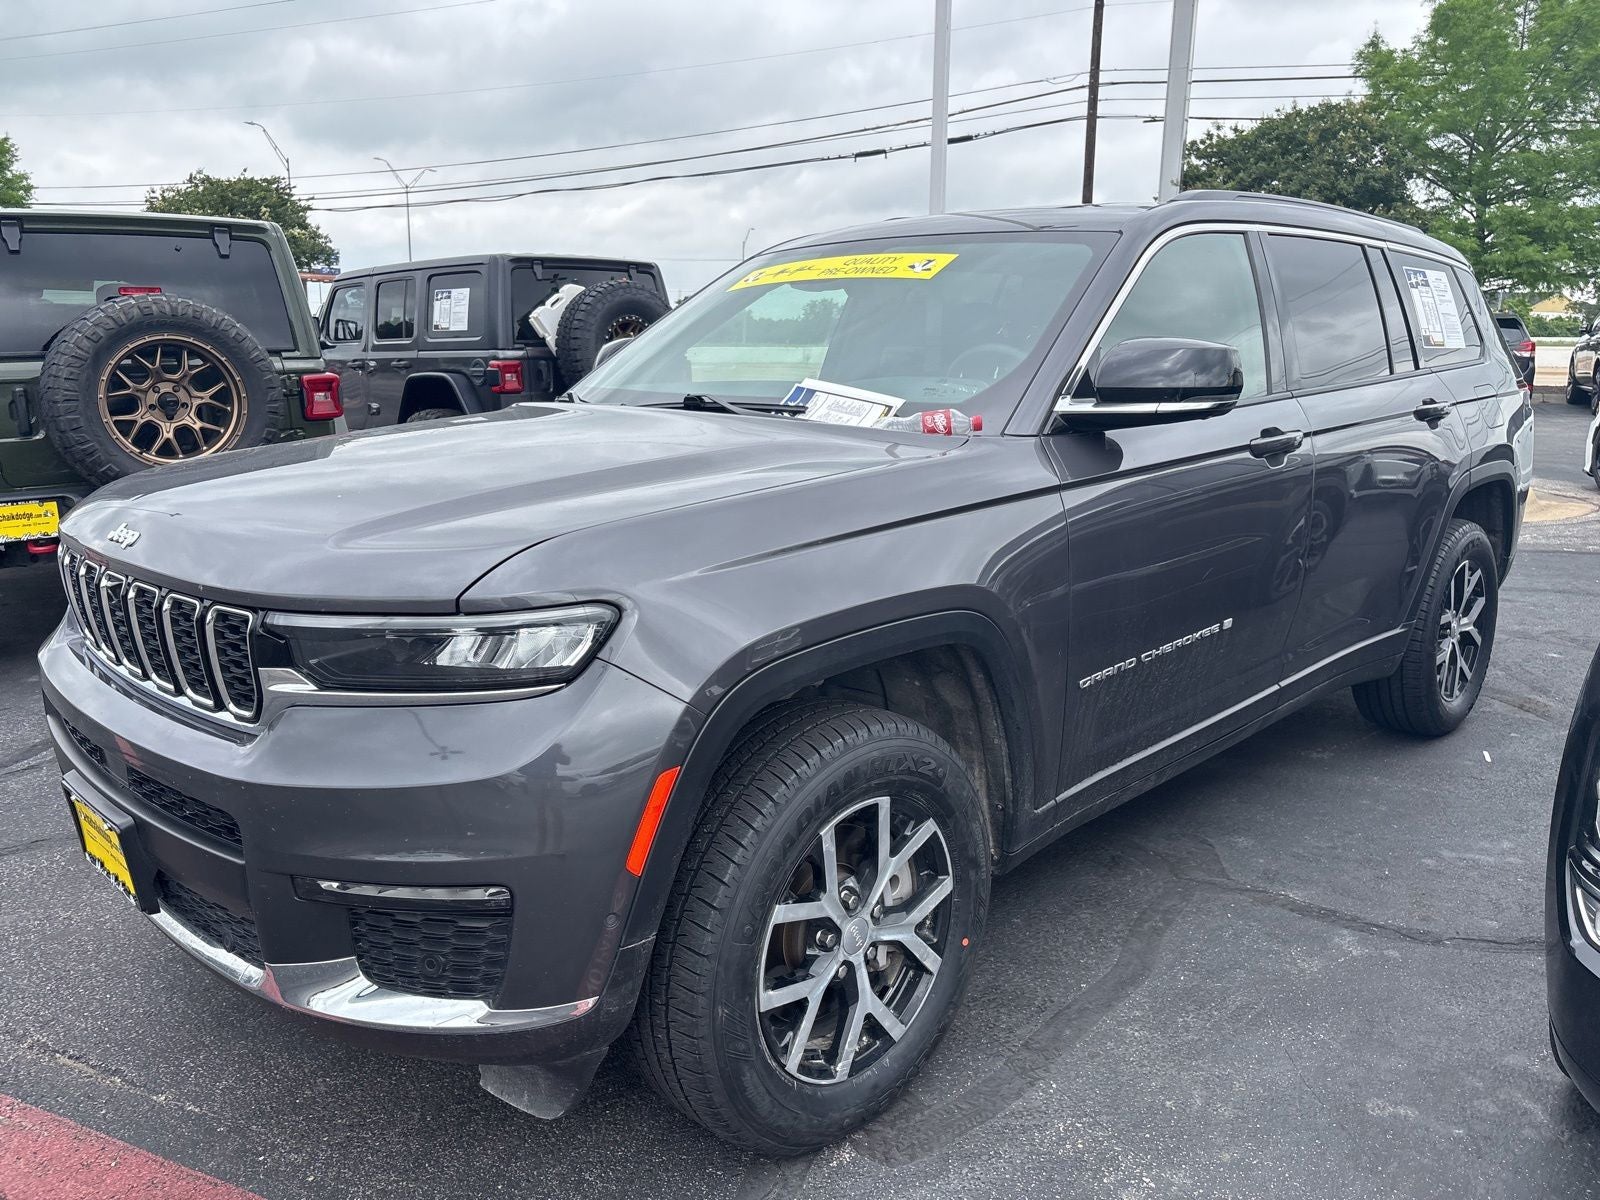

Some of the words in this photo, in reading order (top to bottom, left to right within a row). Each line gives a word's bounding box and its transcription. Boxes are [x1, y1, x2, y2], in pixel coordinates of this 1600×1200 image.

[817, 265, 898, 277] PRE-OWNED
[843, 256, 903, 267] QUALITY
[107, 522, 140, 549] Jeep
[1079, 657, 1137, 689] GRAND
[1141, 623, 1221, 663] CHEROKEE
